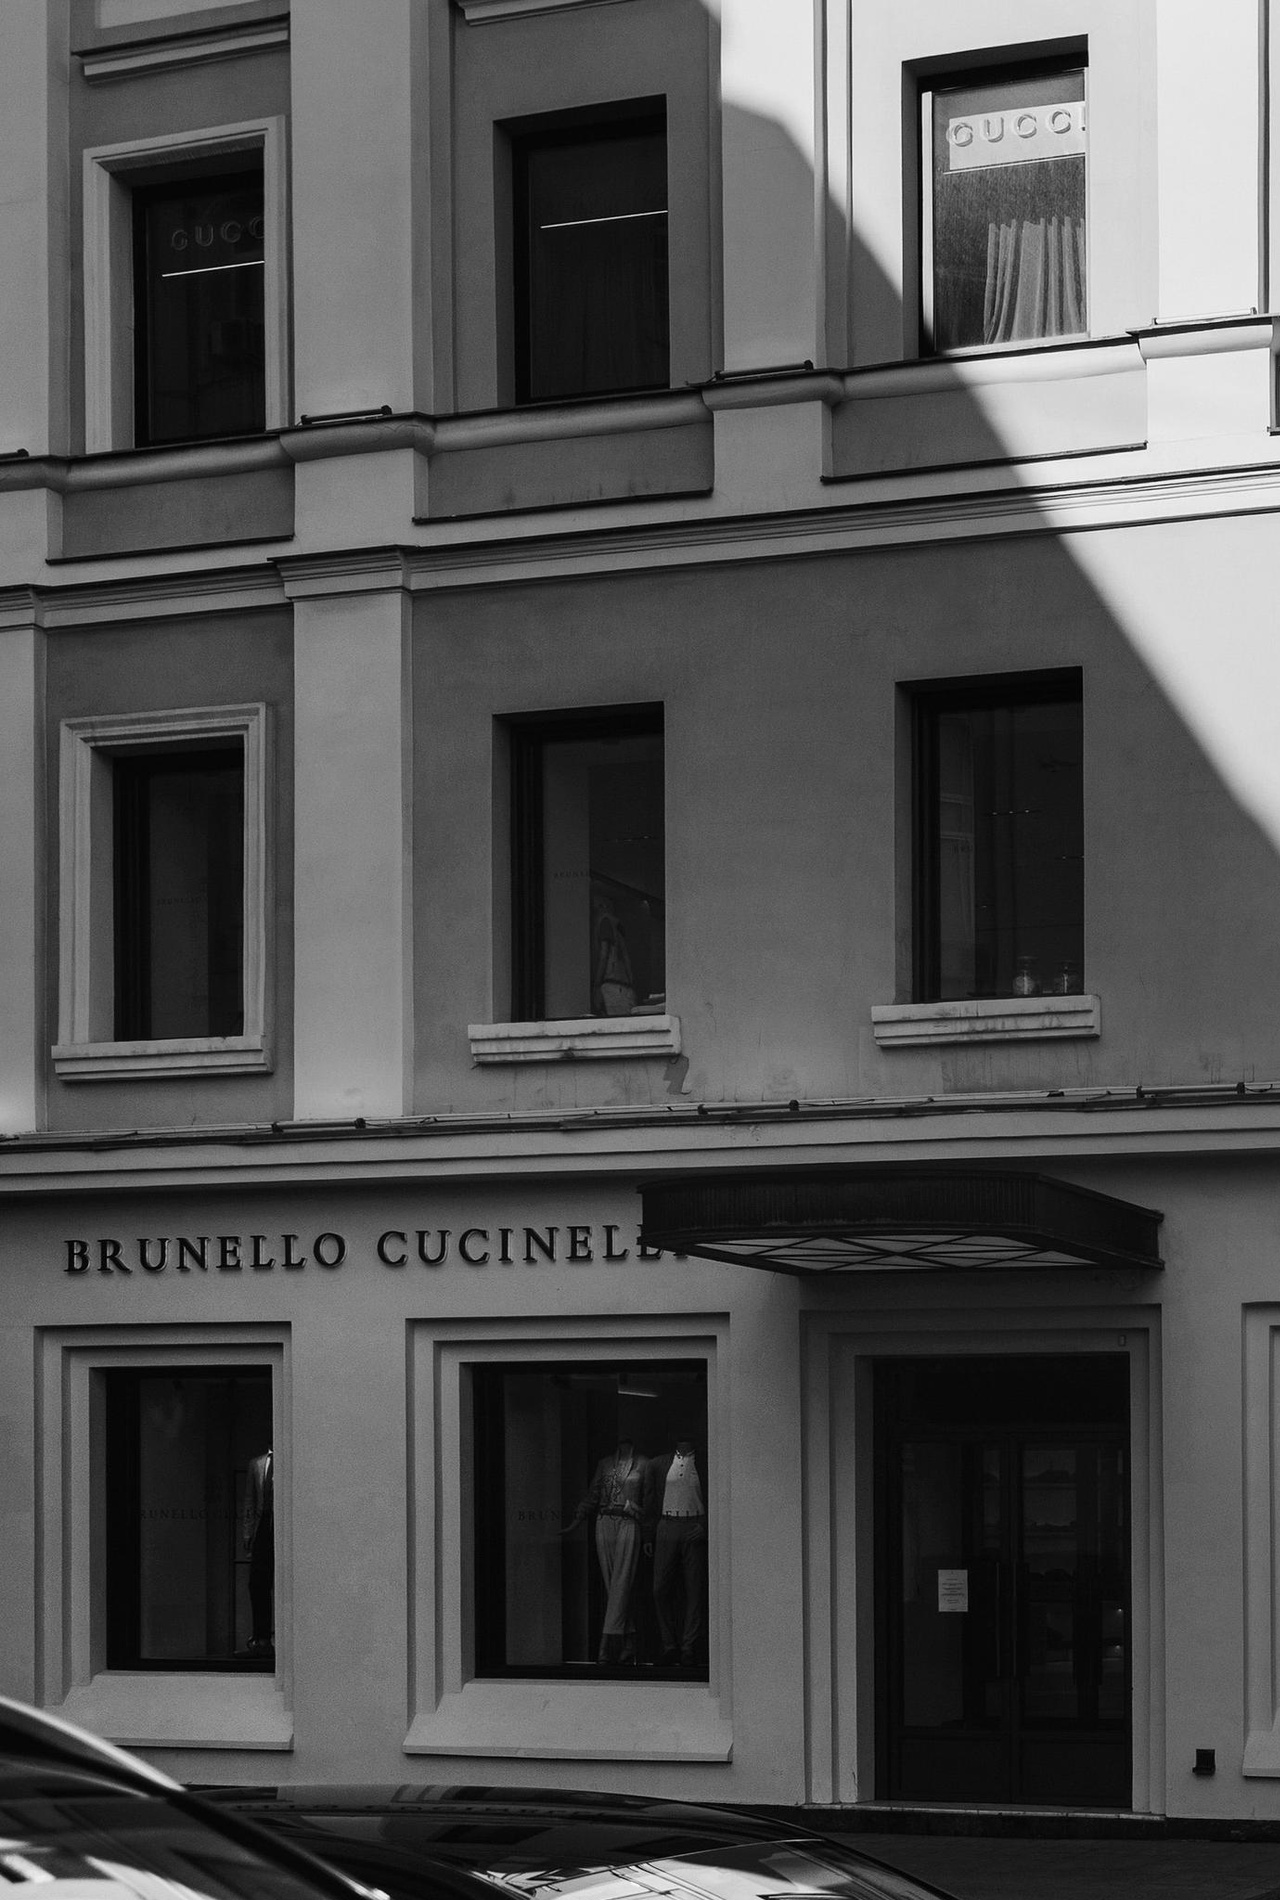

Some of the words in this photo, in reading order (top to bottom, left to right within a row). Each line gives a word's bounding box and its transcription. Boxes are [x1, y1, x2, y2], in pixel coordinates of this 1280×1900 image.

[946, 107, 1086, 148] GUCC
[63, 1230, 348, 1274] BRUNELLO
[376, 1224, 687, 1269] CUCINELL
